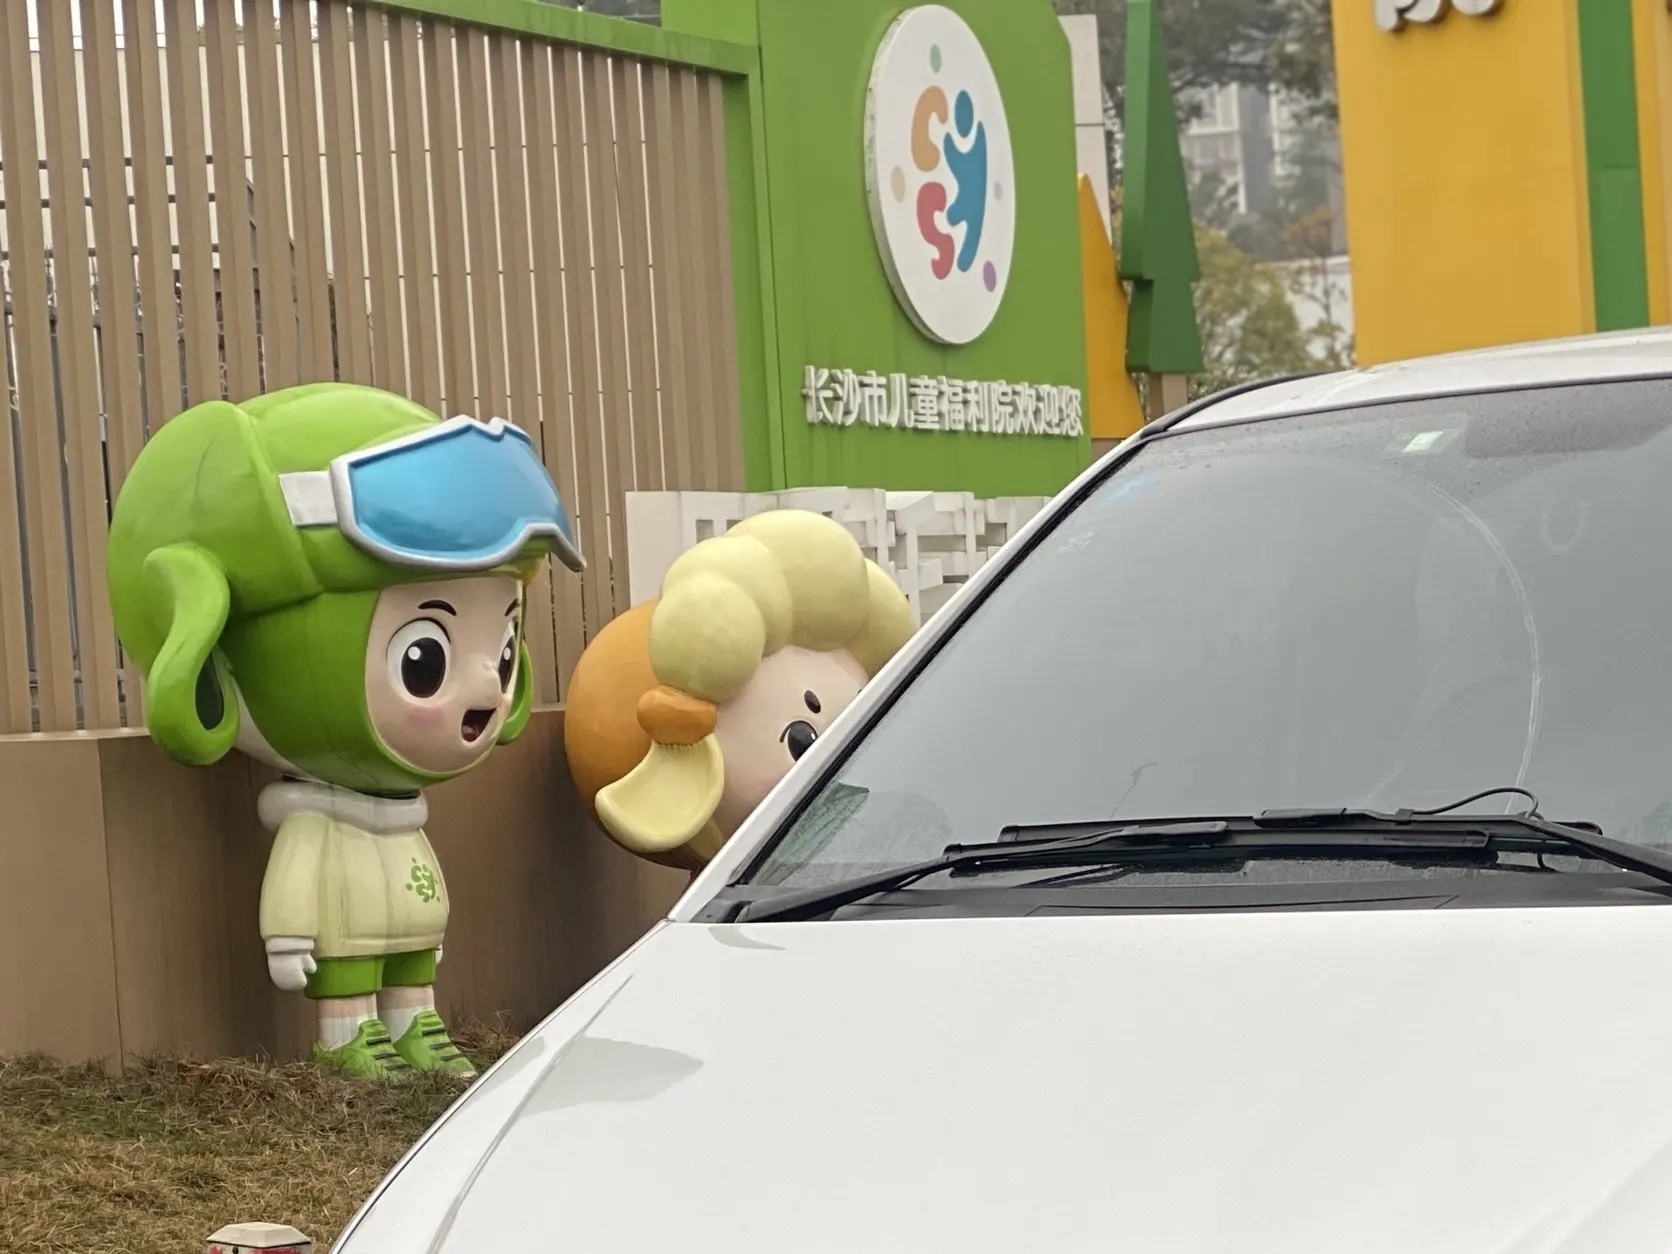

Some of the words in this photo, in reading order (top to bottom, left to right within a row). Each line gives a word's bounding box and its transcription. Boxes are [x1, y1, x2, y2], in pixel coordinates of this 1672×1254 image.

[802, 365, 1083, 436] 长沙市儿童福利院欢迎您
